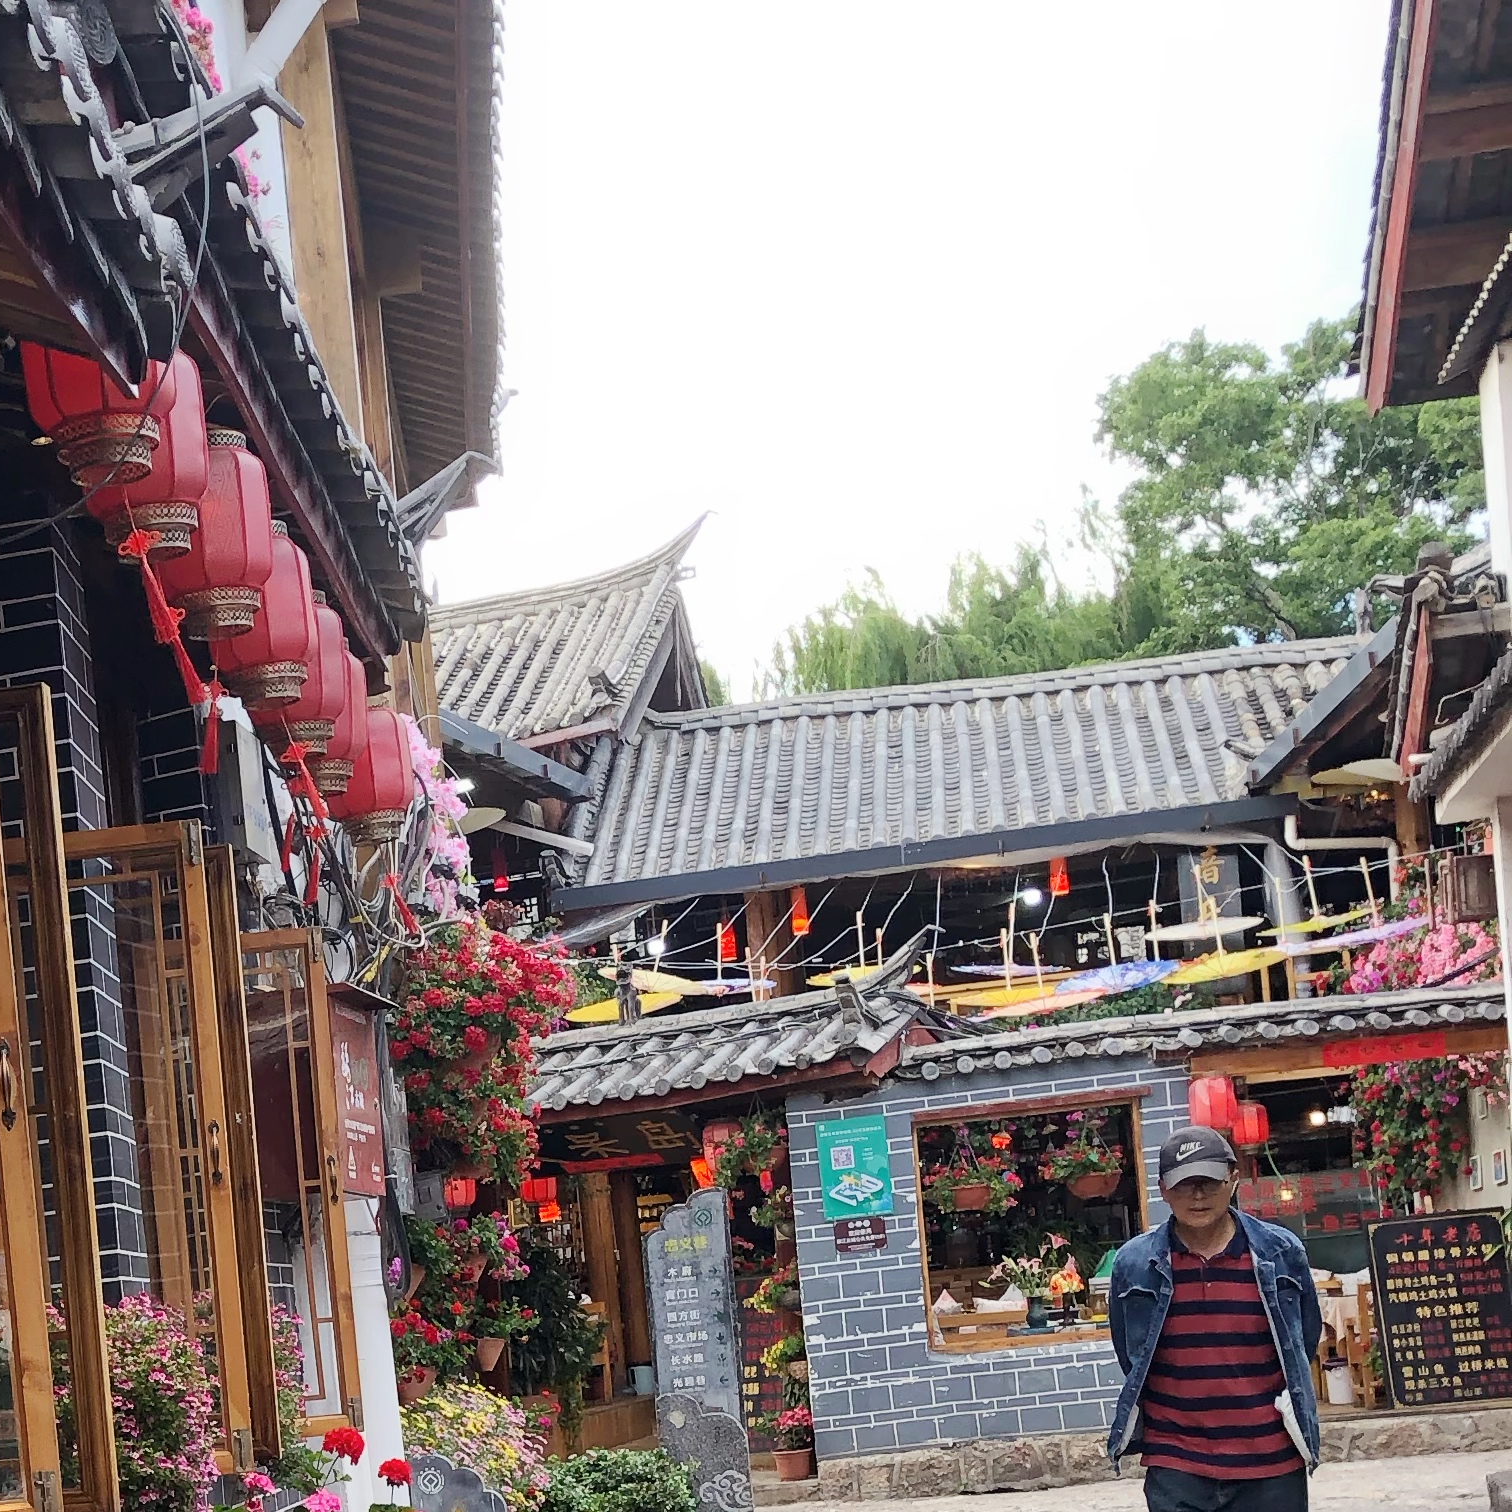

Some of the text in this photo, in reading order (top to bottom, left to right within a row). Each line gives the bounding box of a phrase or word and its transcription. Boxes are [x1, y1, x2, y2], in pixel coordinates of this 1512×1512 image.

[1179, 1141, 1202, 1153] NIKE
[1394, 1221, 1482, 1246] 十年老店
[667, 1265, 693, 1278] 木府
[666, 1310, 701, 1323] 四方街
[1415, 1301, 1480, 1319] 特色推荐
[663, 1330, 709, 1345] 忠义市场
[670, 1352, 705, 1366] 长水路
